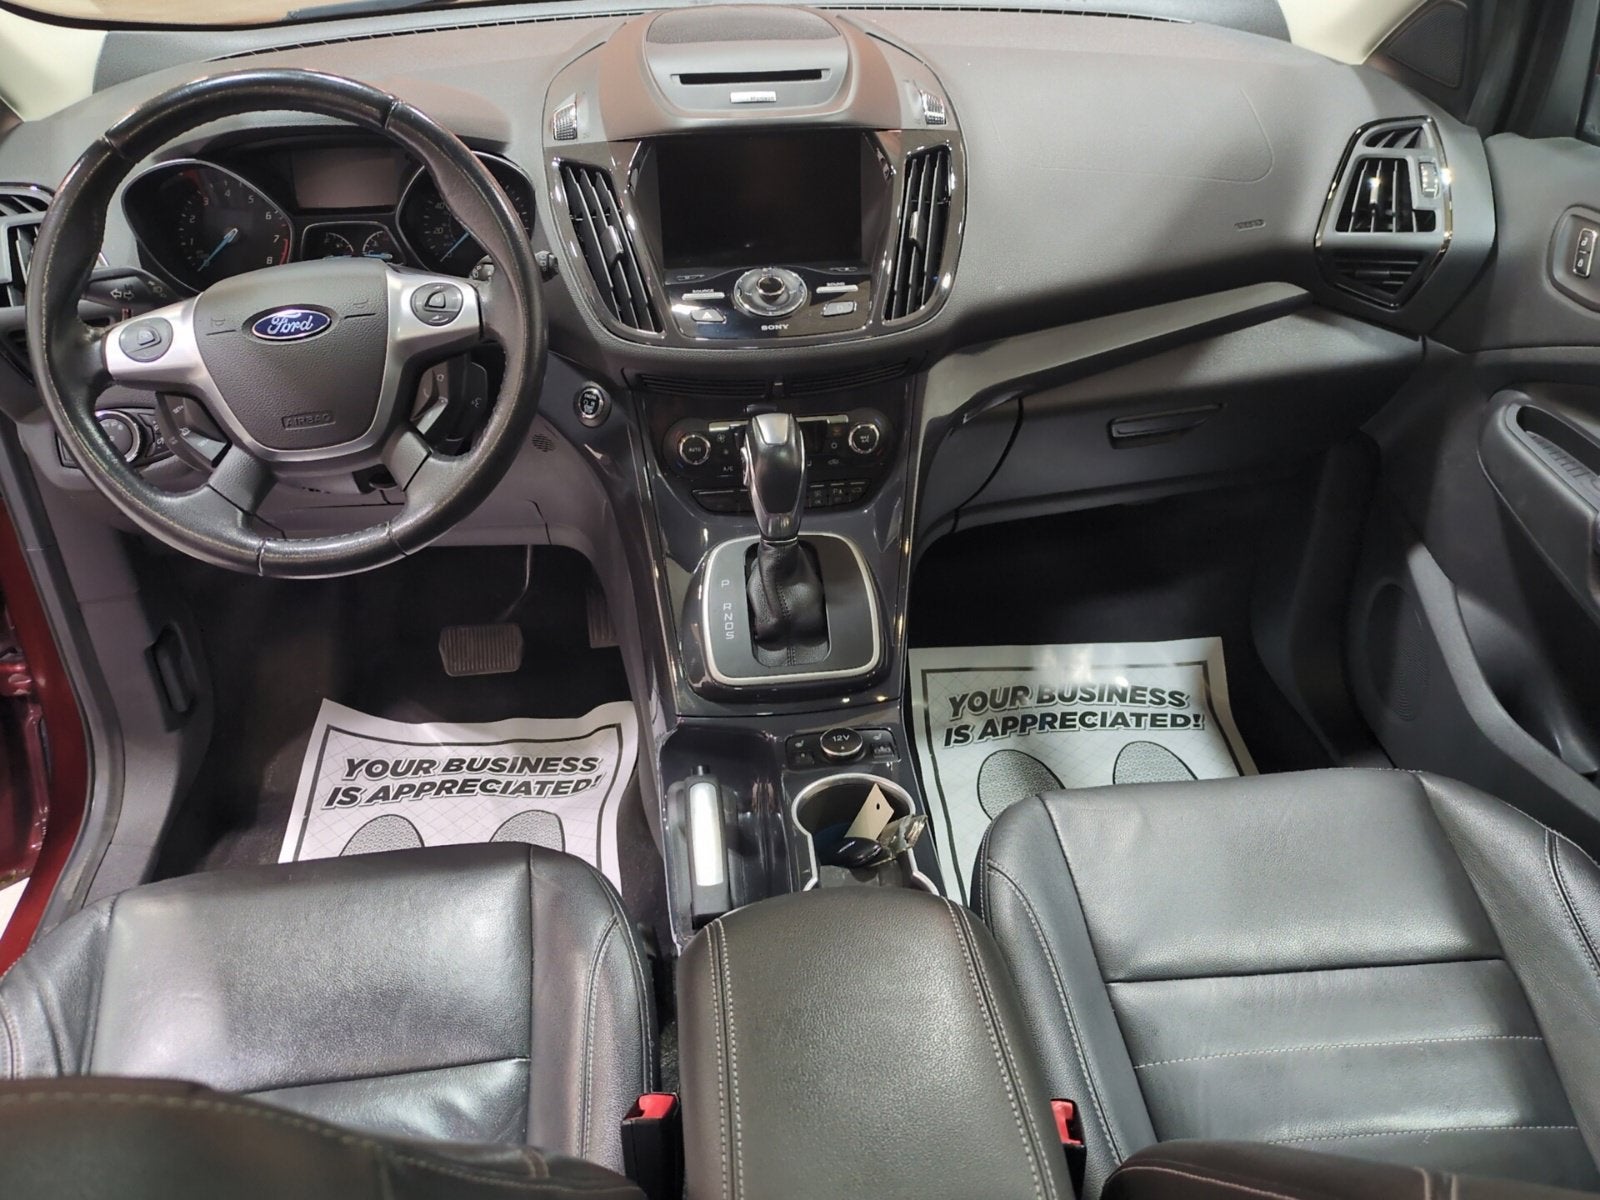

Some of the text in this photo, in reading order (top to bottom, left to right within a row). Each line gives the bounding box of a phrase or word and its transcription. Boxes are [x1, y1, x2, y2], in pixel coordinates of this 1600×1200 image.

[266, 312, 314, 335] Ford
[760, 323, 789, 331] SONY
[721, 579, 730, 588] P
[723, 602, 732, 611] R
[724, 612, 733, 621] N
[724, 621, 734, 631] D
[725, 631, 735, 640] S
[949, 683, 1190, 720] YOUR BUSINESS
[944, 711, 1204, 747] IS APPRECIATED!
[832, 734, 850, 742] 12V
[342, 756, 601, 780] YOUR BUSINESS
[322, 774, 603, 808] IS APPRECIATED!
